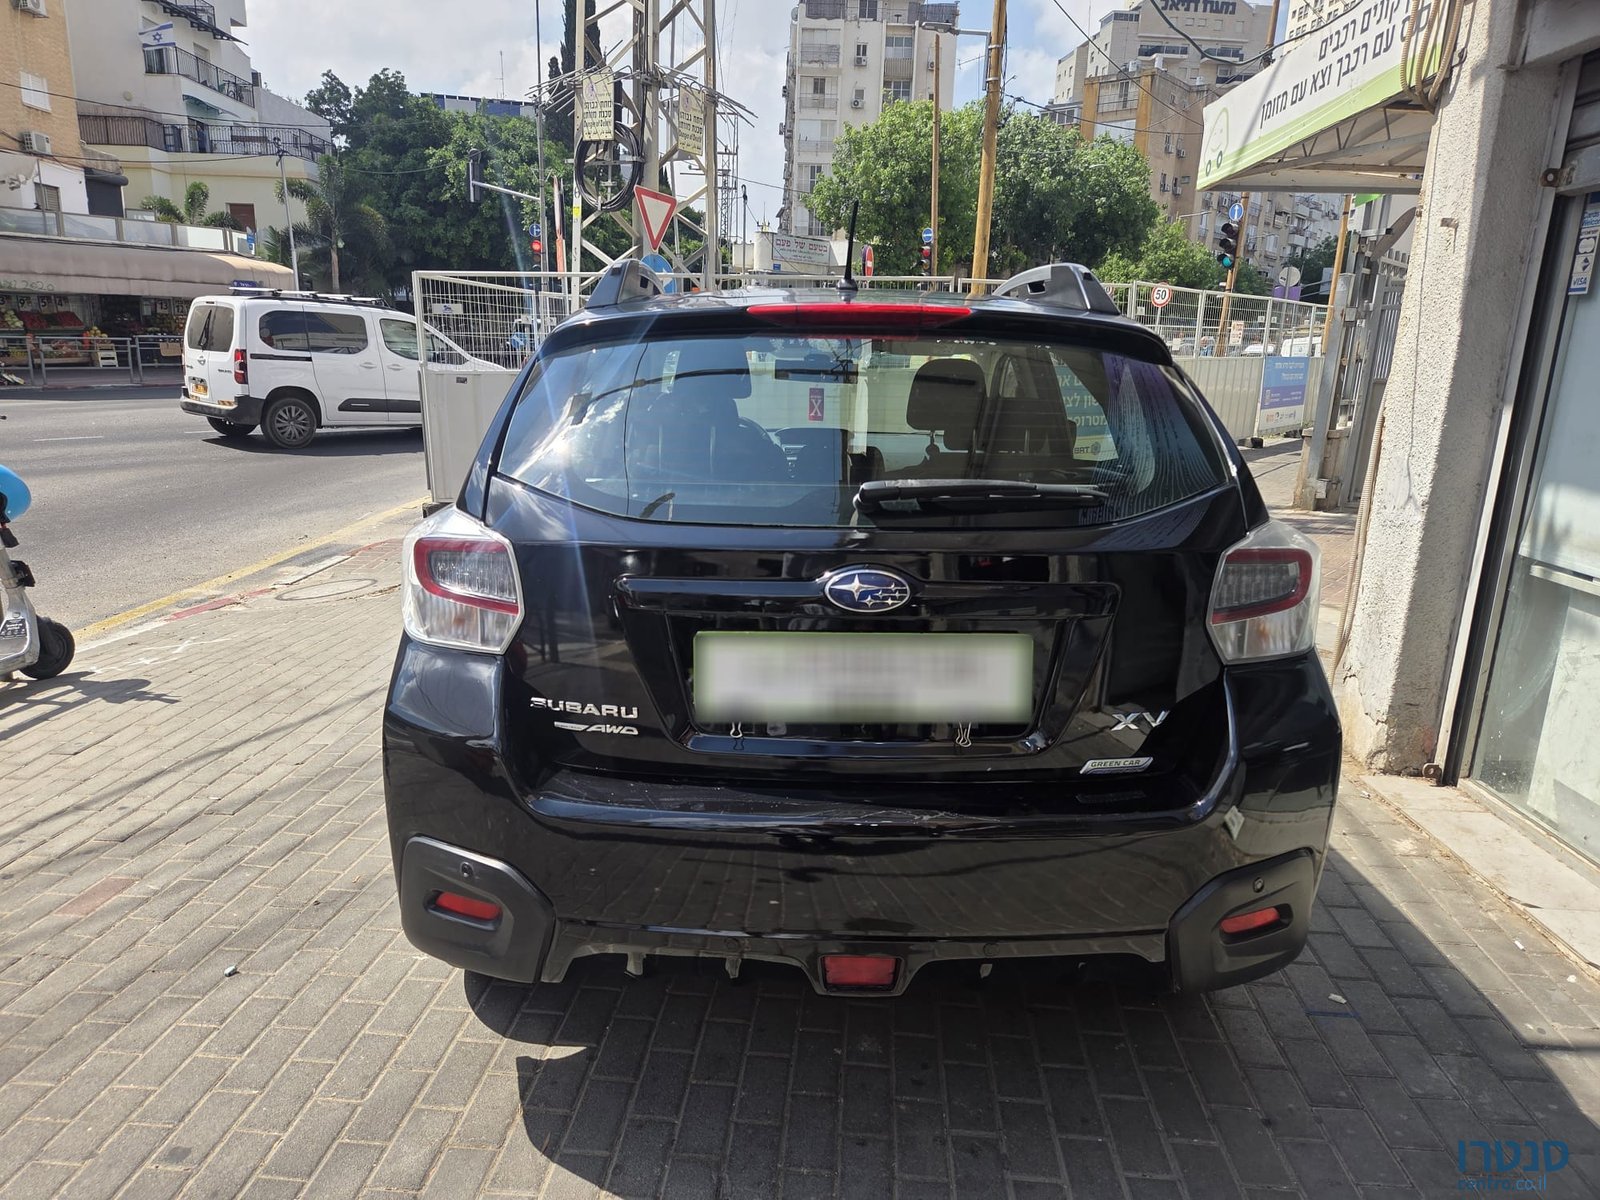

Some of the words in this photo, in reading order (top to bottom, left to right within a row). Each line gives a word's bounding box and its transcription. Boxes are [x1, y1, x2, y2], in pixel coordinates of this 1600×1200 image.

[1319, 19, 1357, 61] רכבים
[1372, 25, 1396, 60] עם
[1337, 43, 1368, 87] רכבך
[1310, 63, 1333, 95] וצא
[1290, 78, 1308, 107] עם
[1260, 90, 1289, 129] מזומן
[775, 238, 791, 247] פעם
[794, 239, 806, 249] של
[808, 243, 828, 253] בטעם
[1573, 277, 1587, 286] VISA
[1155, 289, 1167, 300] 50
[530, 697, 639, 719] SUBARU
[586, 724, 639, 736] AWD
[1110, 710, 1170, 731] XV
[1090, 760, 1121, 768] GREEN
